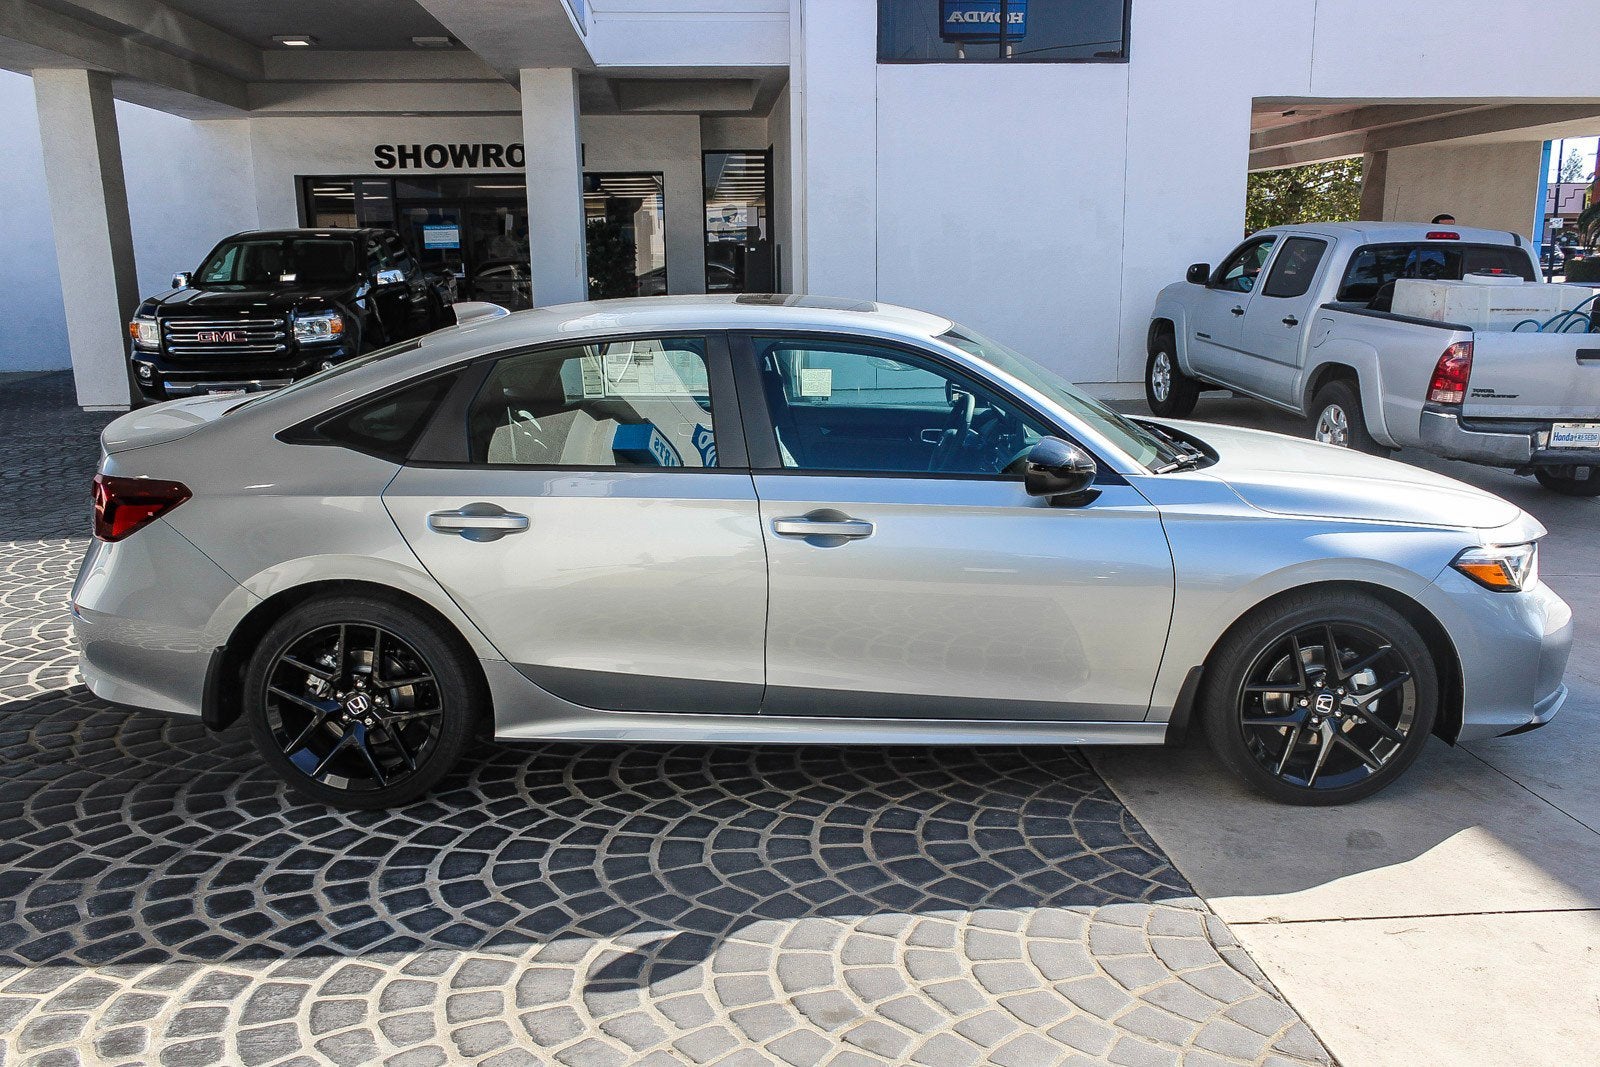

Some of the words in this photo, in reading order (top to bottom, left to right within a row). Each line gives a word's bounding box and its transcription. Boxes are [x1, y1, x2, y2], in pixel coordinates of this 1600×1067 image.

[374, 143, 585, 169] SHOWRO
[198, 331, 248, 343] GMC
[1553, 431, 1574, 442] Honda
